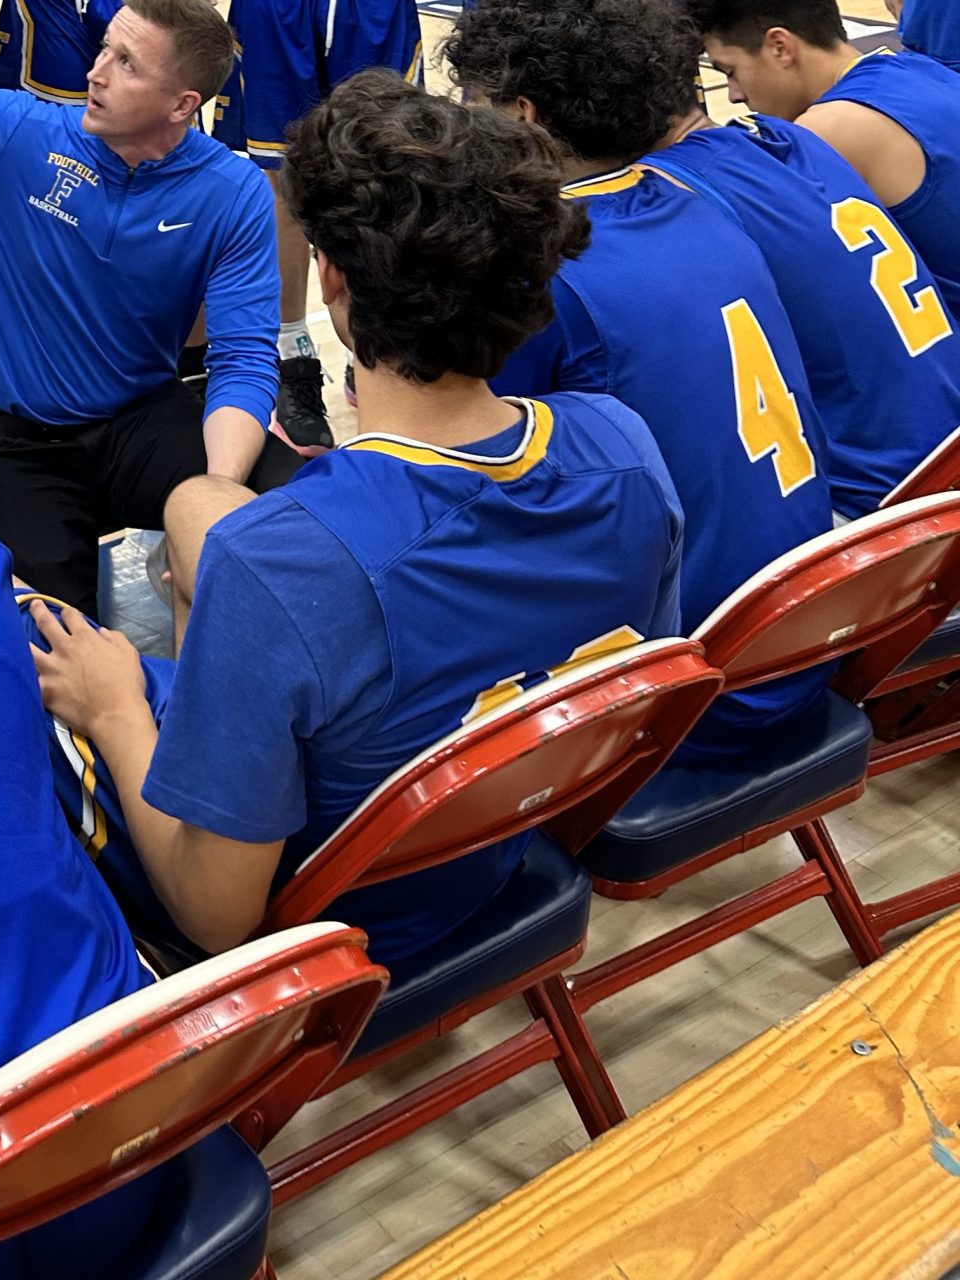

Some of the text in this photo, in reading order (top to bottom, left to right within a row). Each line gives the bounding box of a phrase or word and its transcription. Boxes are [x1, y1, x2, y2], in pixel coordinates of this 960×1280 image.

[44, 168, 82, 207] F
[47, 152, 99, 187] FOOTHILL
[28, 195, 79, 227] BASKETBALL
[831, 197, 953, 358] 2
[721, 297, 817, 497] 4
